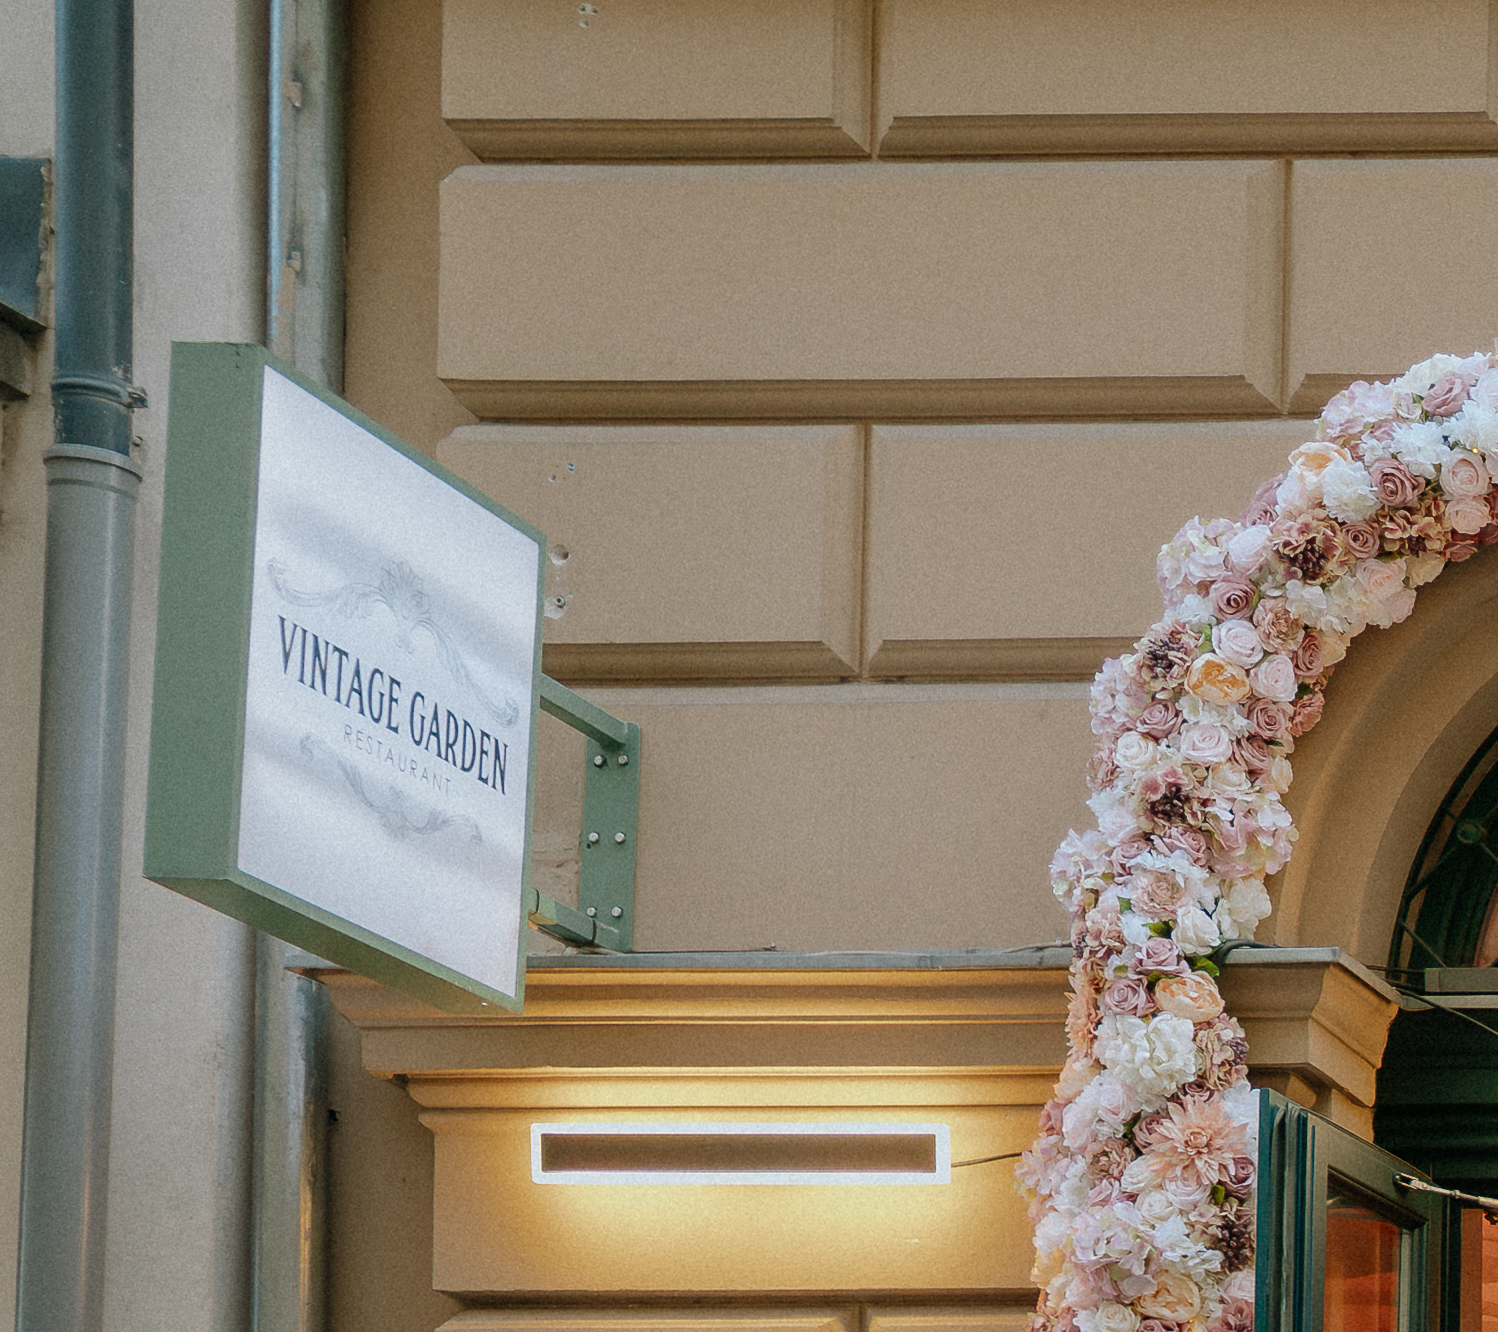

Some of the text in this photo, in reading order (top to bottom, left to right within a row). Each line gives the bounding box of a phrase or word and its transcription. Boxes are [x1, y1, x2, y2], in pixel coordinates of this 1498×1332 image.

[277, 614, 509, 796] VINTAGE GARDEN
[343, 722, 452, 797] RESTAURANT
